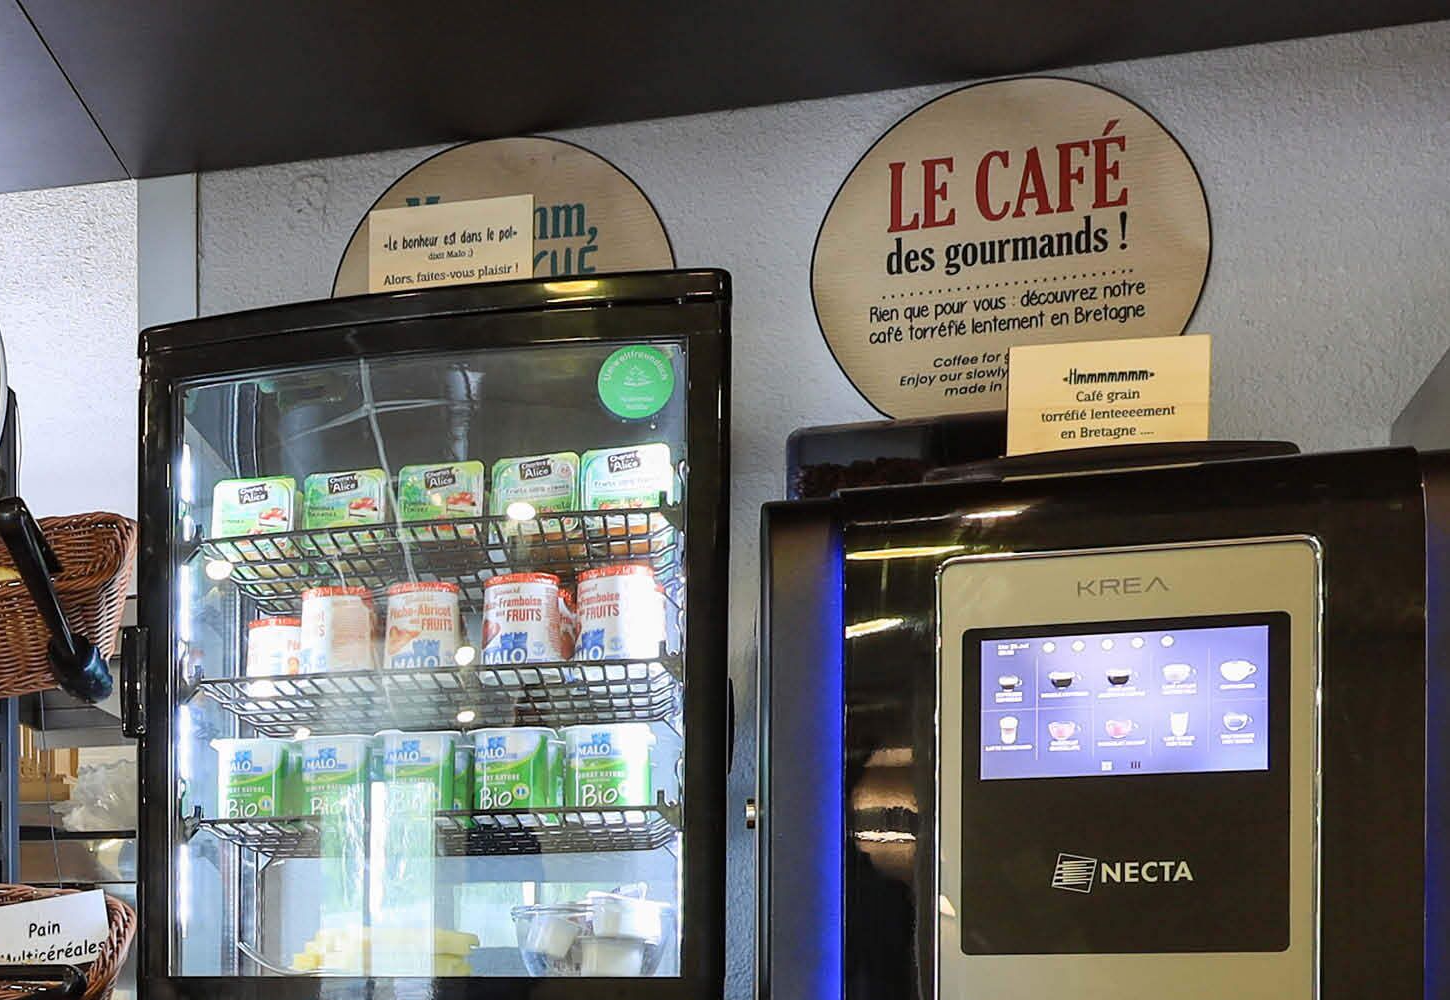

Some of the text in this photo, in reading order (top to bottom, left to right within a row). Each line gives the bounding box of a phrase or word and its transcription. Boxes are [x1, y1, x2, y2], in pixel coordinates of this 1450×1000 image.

[887, 119, 1128, 233] LE CAFÉ
[402, 234, 438, 250] bonheur
[444, 231, 456, 245] est
[460, 230, 482, 243] dans
[486, 227, 494, 240] le
[886, 211, 1128, 276] des gourmands !
[417, 268, 475, 283] faites-vous
[477, 263, 512, 279] plaisir
[869, 279, 1146, 329] Rien que pour vous découvrez notre
[869, 301, 1146, 345] café torréfié lentement en Bretagne
[933, 355, 979, 368] Coffee
[982, 353, 1001, 364] for
[899, 366, 1009, 388] Enjoy our slowly
[944, 381, 1002, 396] made in
[1076, 389, 1140, 403] Café grain
[1041, 410, 1087, 423] torréfié
[1060, 426, 1137, 440] en Bretagne
[1077, 576, 1170, 597] KREA
[506, 608, 543, 623] FRUITS
[585, 603, 620, 619] FRUITS
[230, 760, 251, 772] ALO
[479, 786, 513, 810] Bio
[581, 783, 618, 806] Bio
[226, 798, 258, 818] Bio
[1101, 860, 1196, 884] NECTA
[28, 920, 61, 938] Pain
